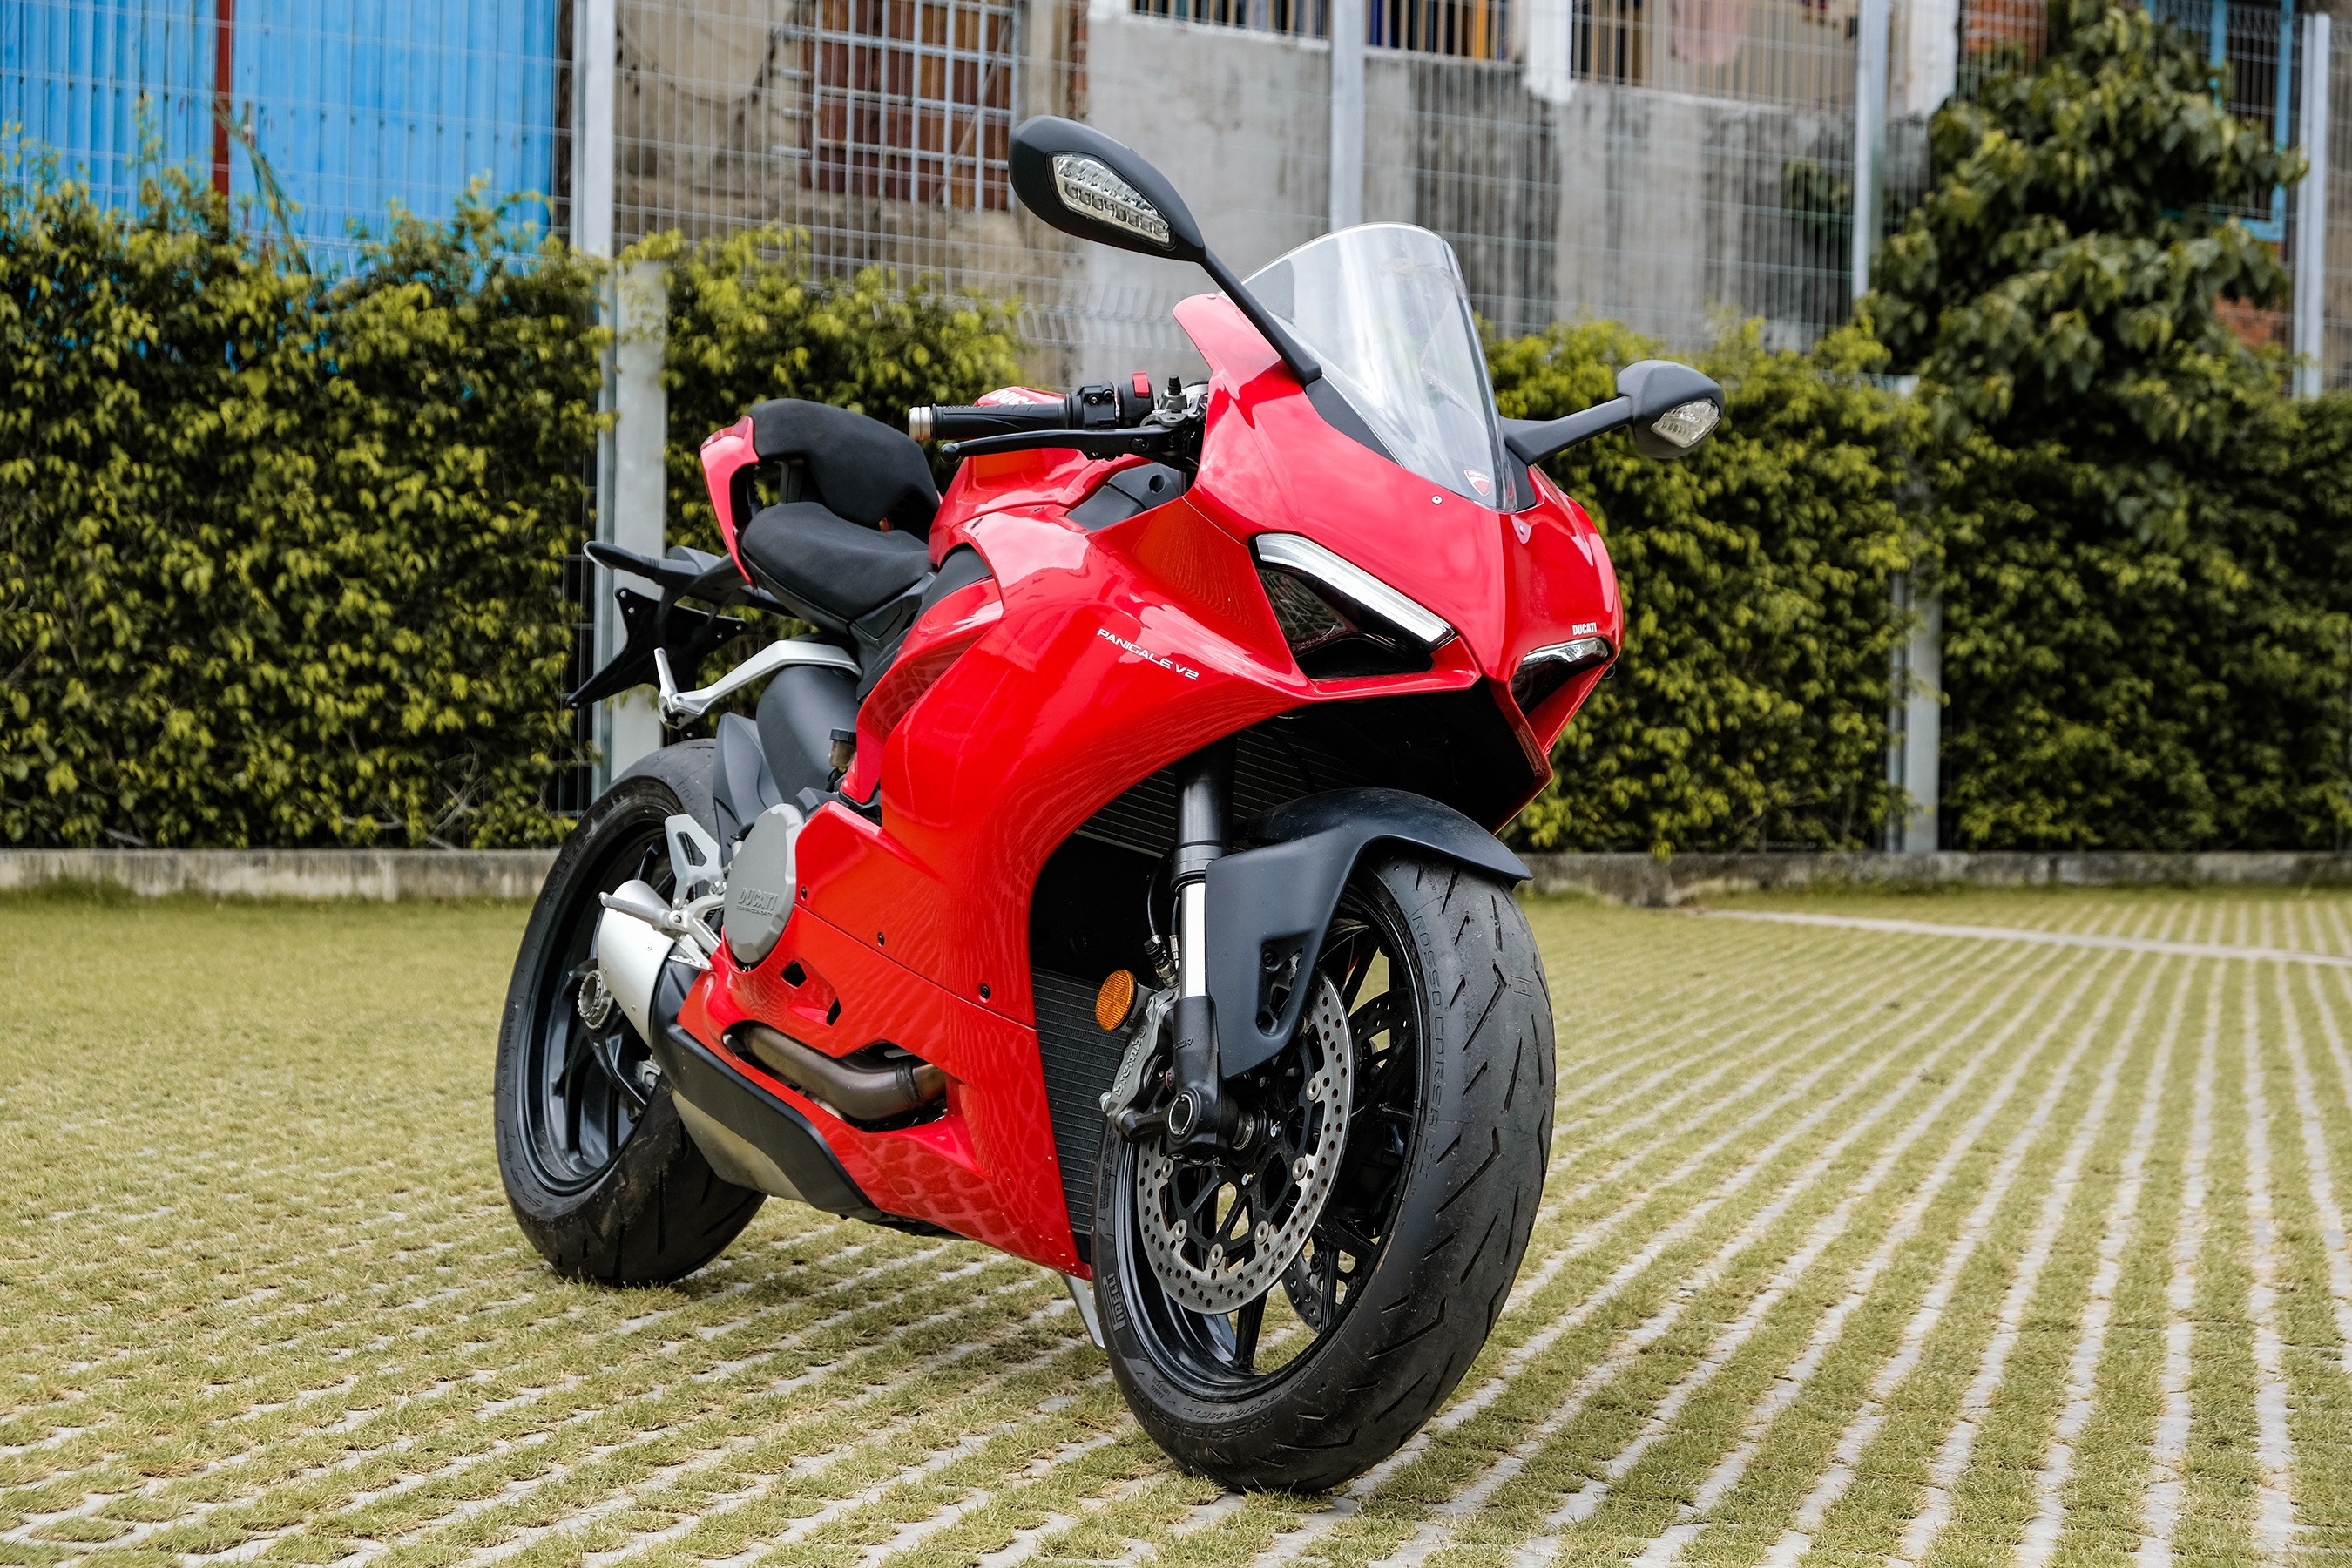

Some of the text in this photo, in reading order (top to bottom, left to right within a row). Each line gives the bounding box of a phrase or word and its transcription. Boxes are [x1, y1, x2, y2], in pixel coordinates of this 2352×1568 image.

[1571, 622, 1598, 636] DUCATI
[1097, 628, 1200, 681] PANIGALE V2
[738, 887, 779, 911] DUCATI
[1412, 916, 1443, 1010] ROSSO
[1428, 1017, 1446, 1132] CORSA
[1113, 1025, 1148, 1098] brembo
[1102, 1272, 1126, 1332] PIRELLI
[1149, 1404, 1205, 1440] CORSA
[1208, 1410, 1274, 1442] ROSSO
